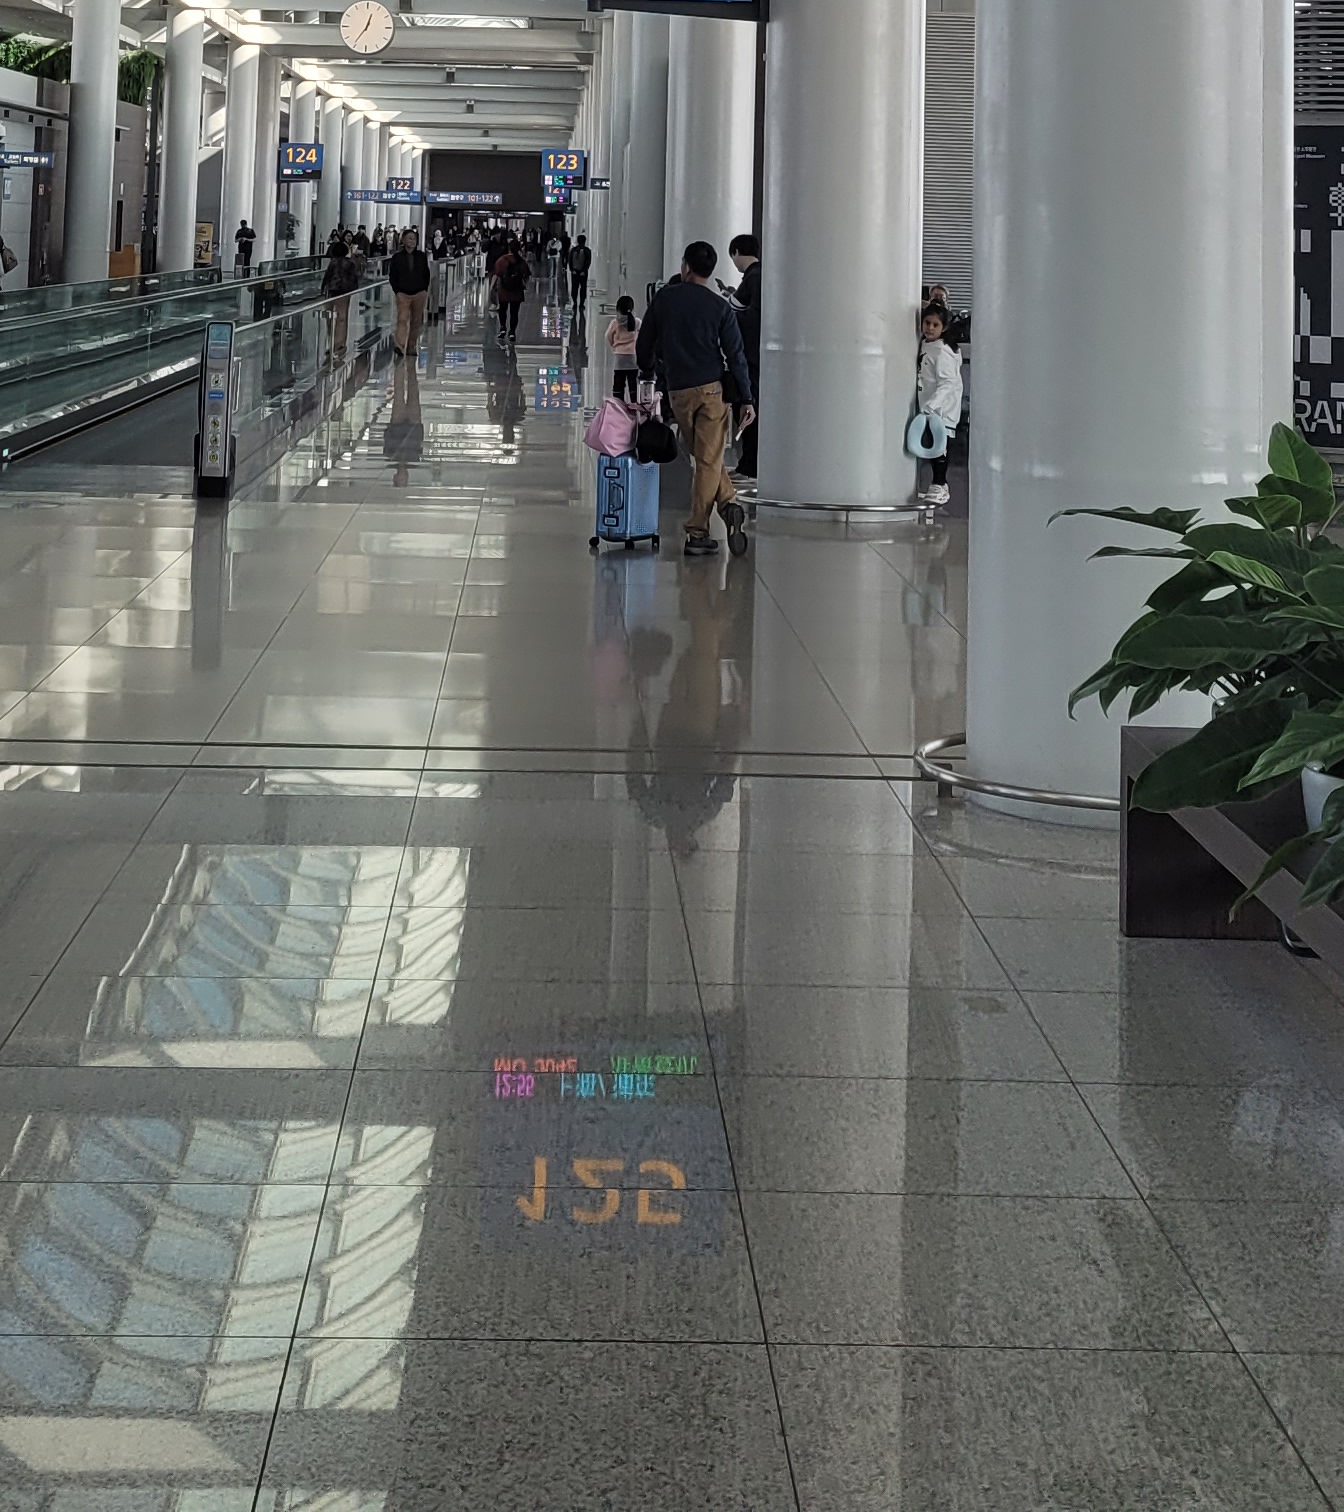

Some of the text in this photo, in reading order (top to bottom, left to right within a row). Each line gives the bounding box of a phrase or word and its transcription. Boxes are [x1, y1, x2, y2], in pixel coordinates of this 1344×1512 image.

[286, 147, 318, 164] 124
[548, 153, 578, 170] 123
[391, 179, 411, 190] 122
